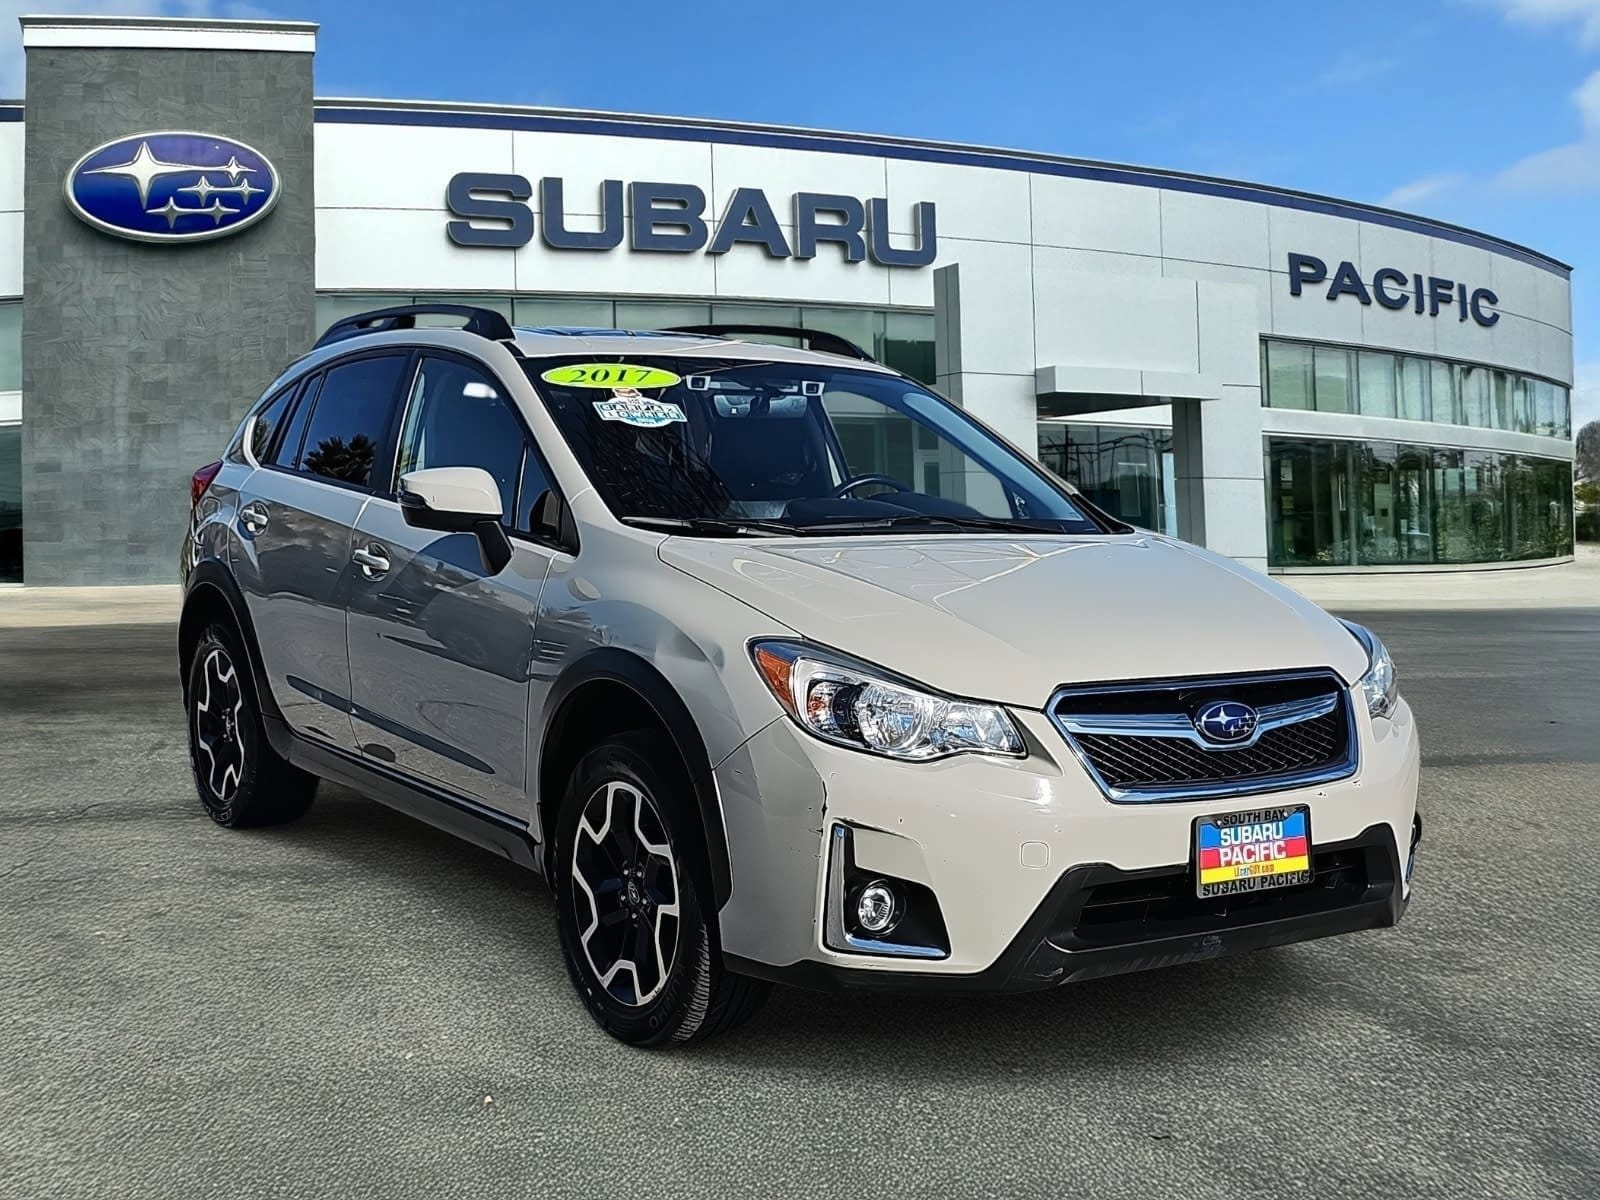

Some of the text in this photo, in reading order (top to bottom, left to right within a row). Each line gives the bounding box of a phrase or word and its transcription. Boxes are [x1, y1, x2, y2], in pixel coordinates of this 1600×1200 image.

[447, 172, 937, 268] SUBARU
[1288, 252, 1500, 327] PACIFIC
[569, 369, 653, 383] 2017
[1223, 809, 1286, 826] SOUTH BAY
[1220, 821, 1284, 846] SUBARU
[1220, 841, 1287, 867] PACIFIC
[1202, 871, 1310, 897] SUBARU PACIFIC
